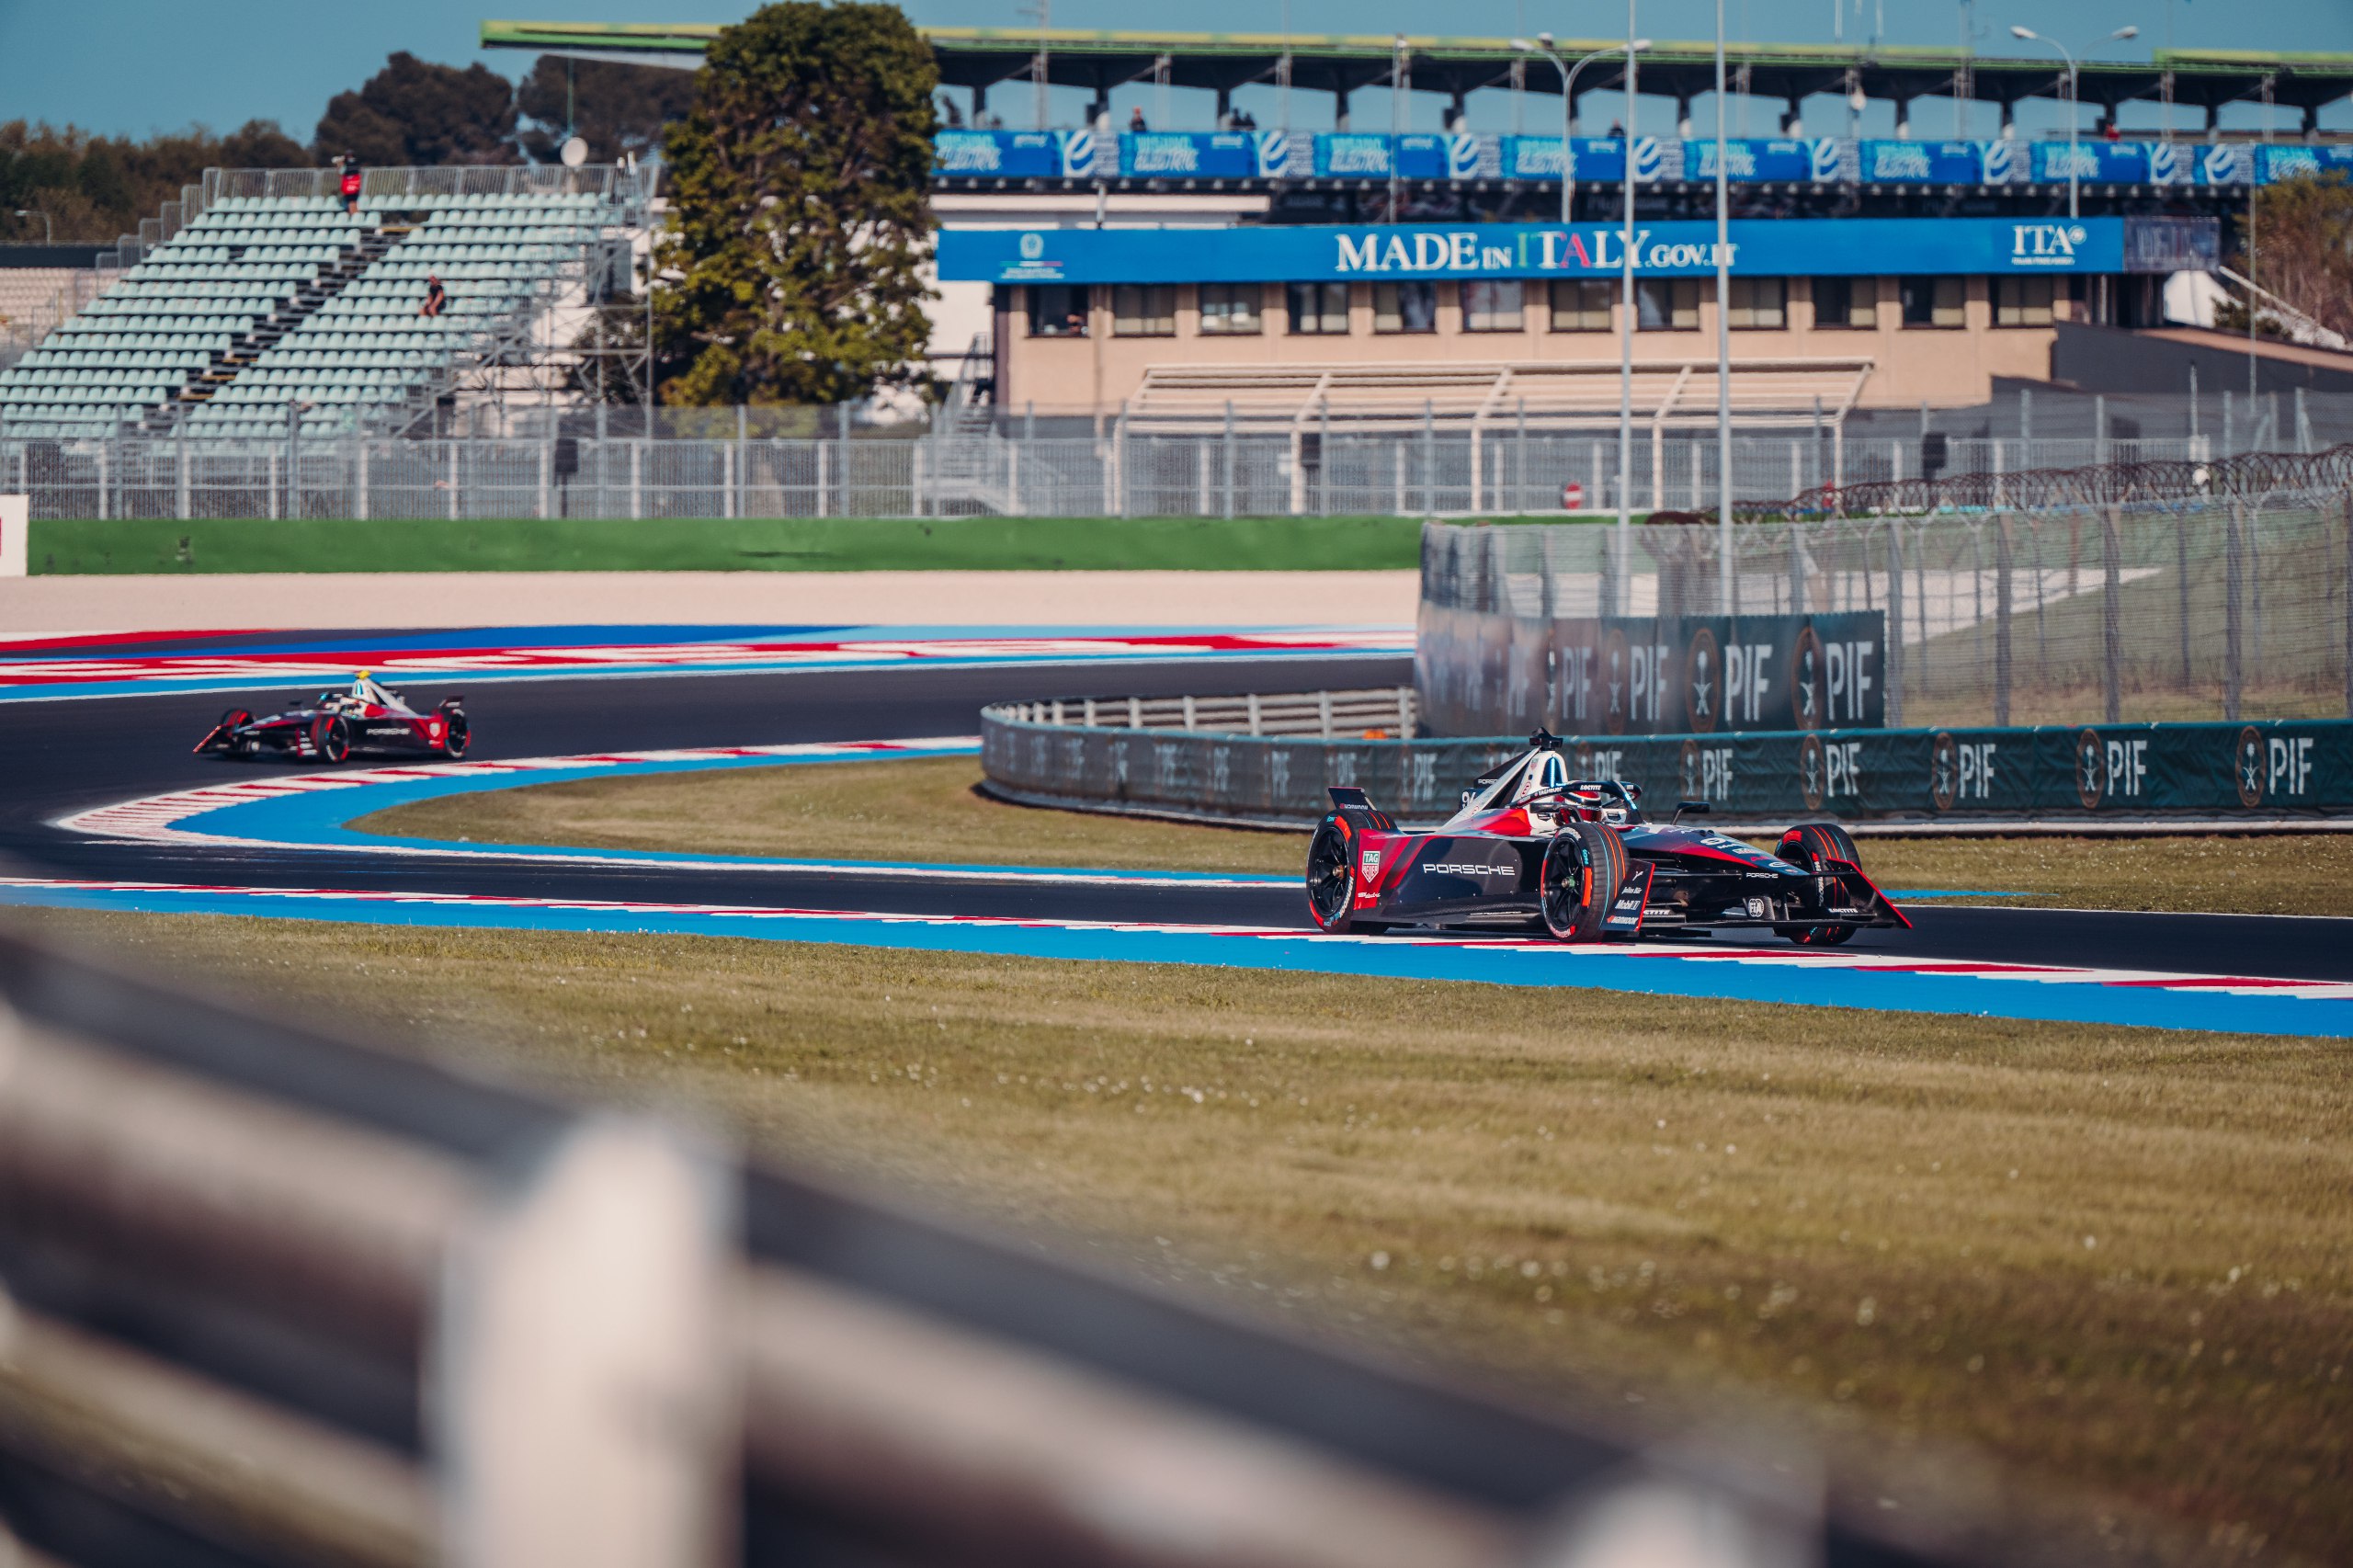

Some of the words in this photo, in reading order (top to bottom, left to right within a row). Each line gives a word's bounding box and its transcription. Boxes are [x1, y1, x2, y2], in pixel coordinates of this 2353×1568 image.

[1563, 646, 1592, 720] PIF
[1631, 645, 1668, 721] PIF
[1724, 644, 1772, 722] PIF
[1825, 642, 1873, 721] PIF
[1702, 748, 1733, 801] PIF
[1825, 743, 1861, 797] PIF
[1960, 743, 1996, 799] PIF
[2108, 740, 2148, 796] PIF
[2269, 738, 2313, 795] PIF
[1365, 853, 1379, 862] TAG
[1423, 864, 1515, 876] PORSCHE
